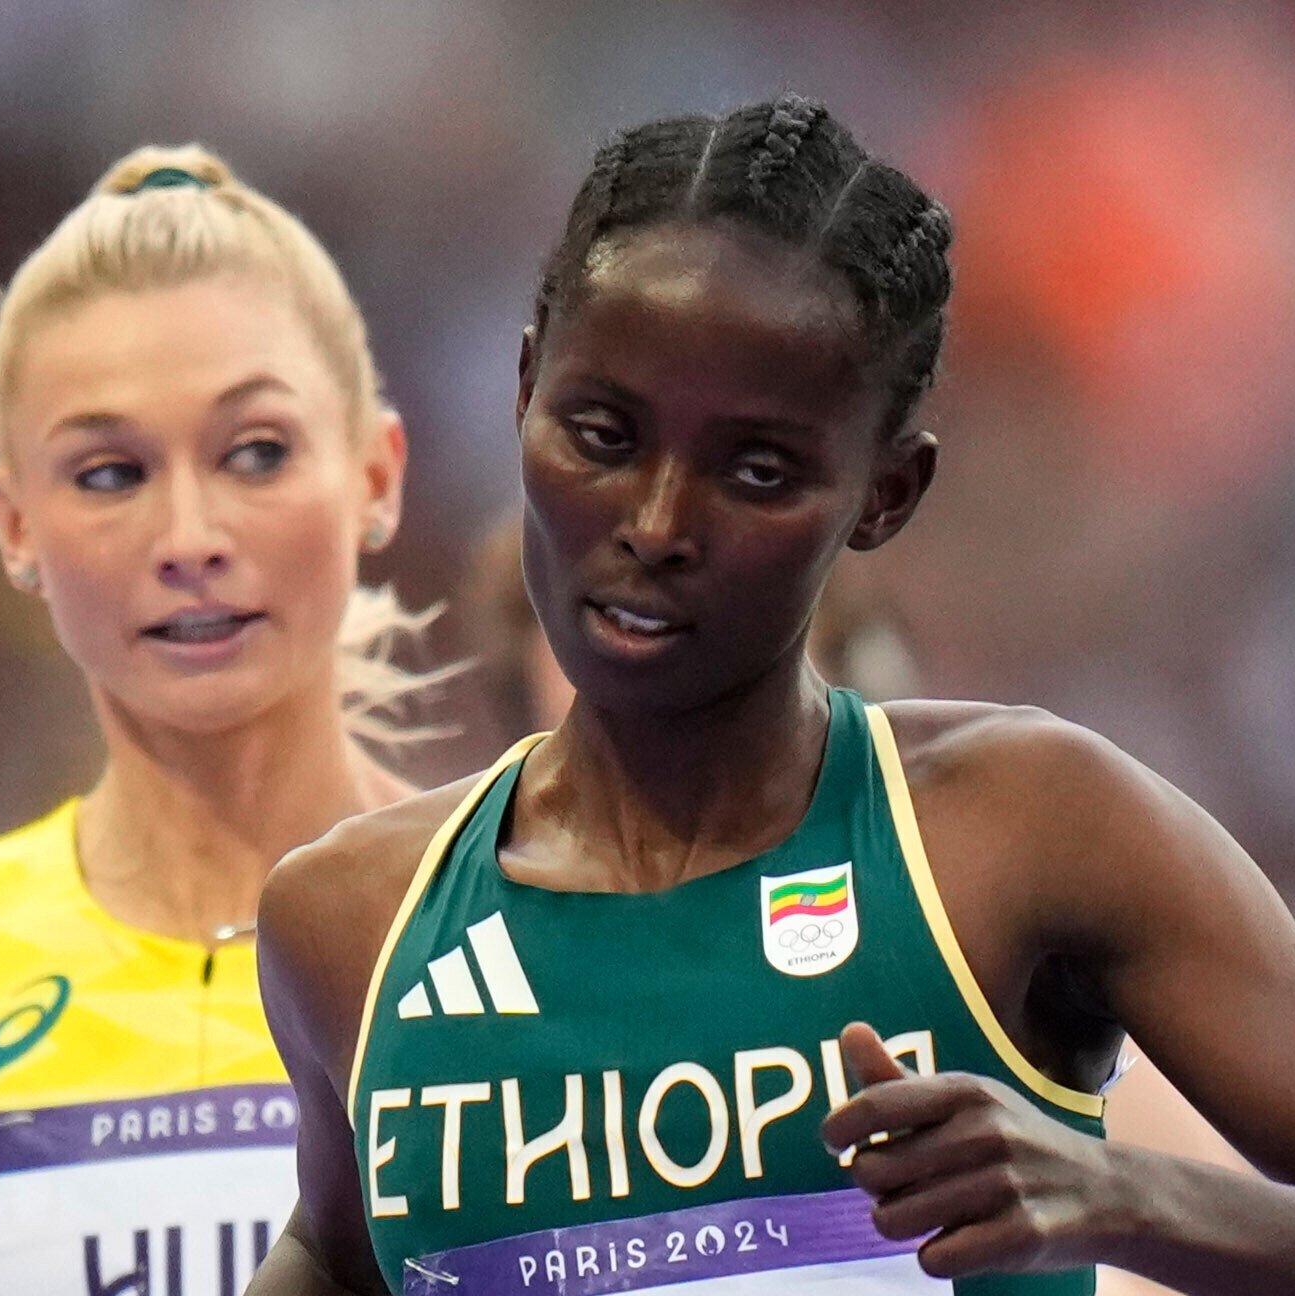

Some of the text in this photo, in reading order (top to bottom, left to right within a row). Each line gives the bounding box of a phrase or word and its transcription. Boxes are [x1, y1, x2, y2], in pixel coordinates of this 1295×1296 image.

[787, 951, 837, 967] ETHIOPIA
[91, 1096, 297, 1147] PARIS 20
[518, 1218, 789, 1287] PARIS 2024
